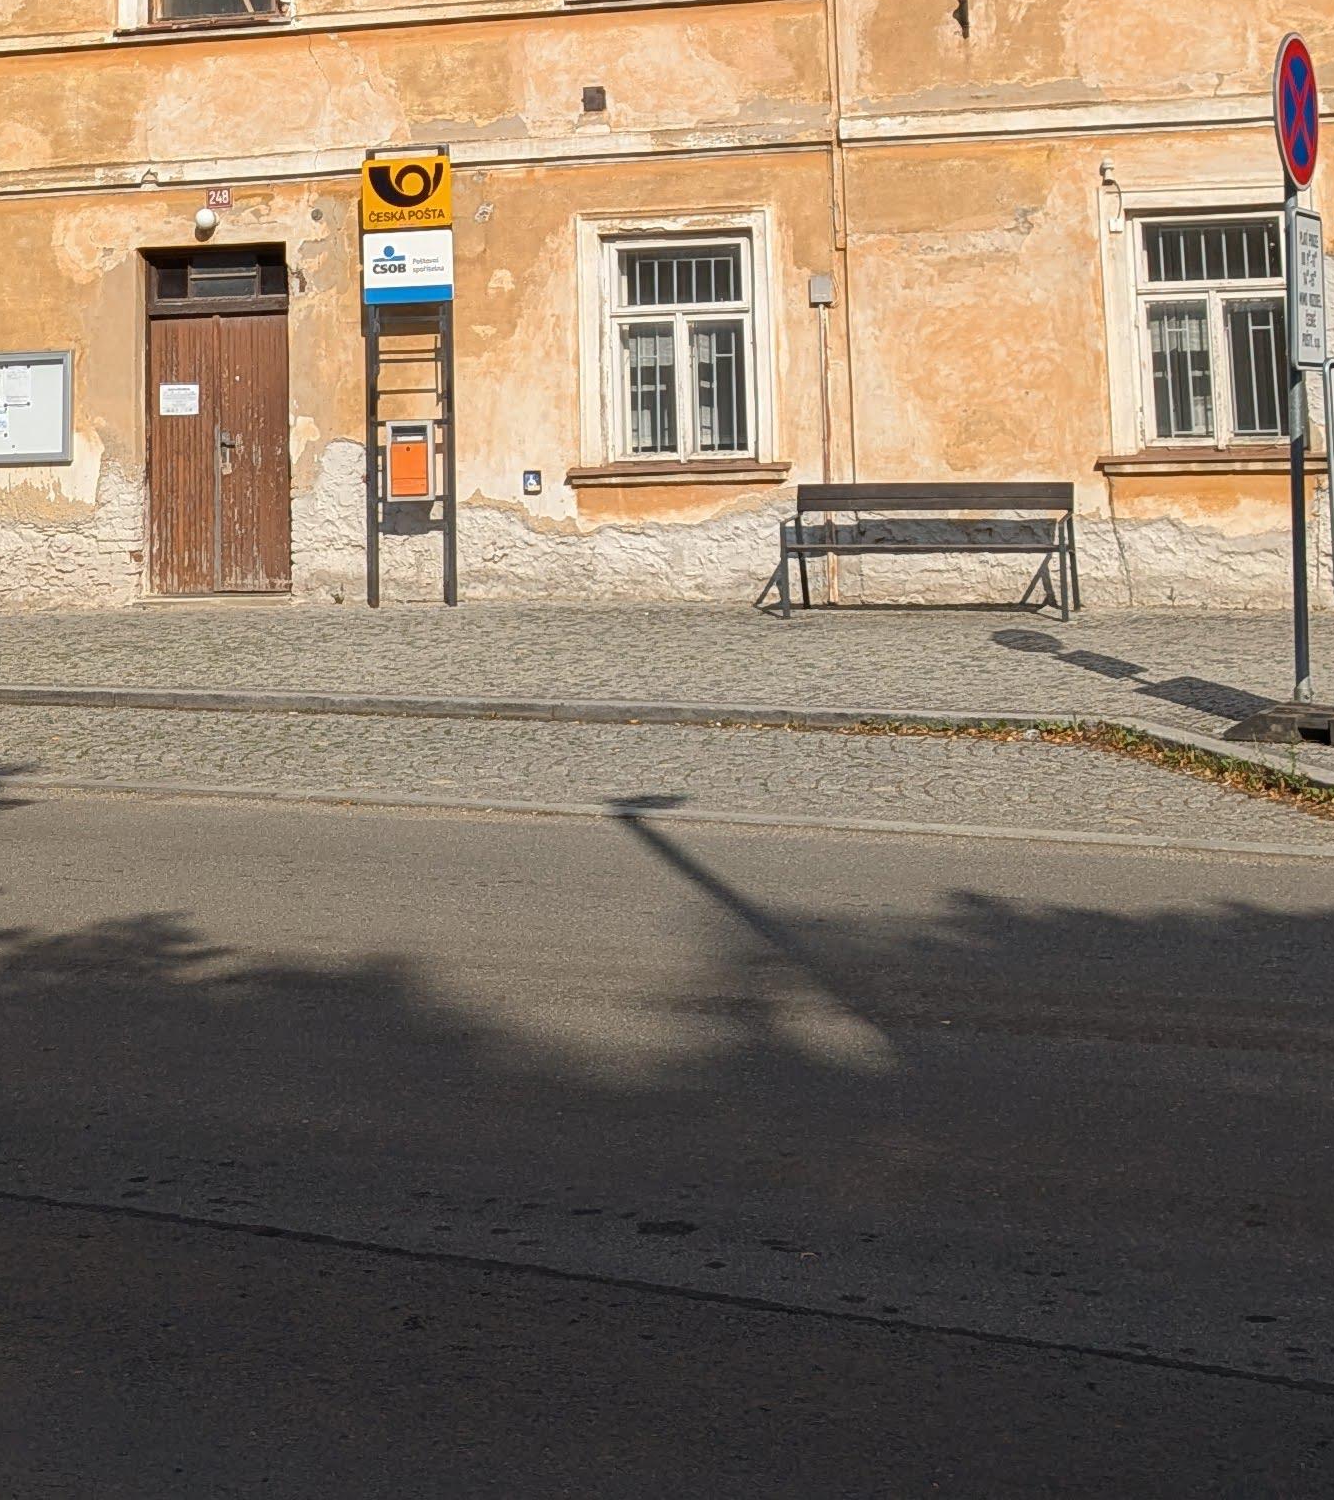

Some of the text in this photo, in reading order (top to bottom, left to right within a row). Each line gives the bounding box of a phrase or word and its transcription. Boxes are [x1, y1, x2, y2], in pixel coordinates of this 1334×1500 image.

[209, 190, 229, 204] 248
[368, 207, 446, 222] ČESKÁ POŠTA
[373, 263, 406, 274] ČSOB
